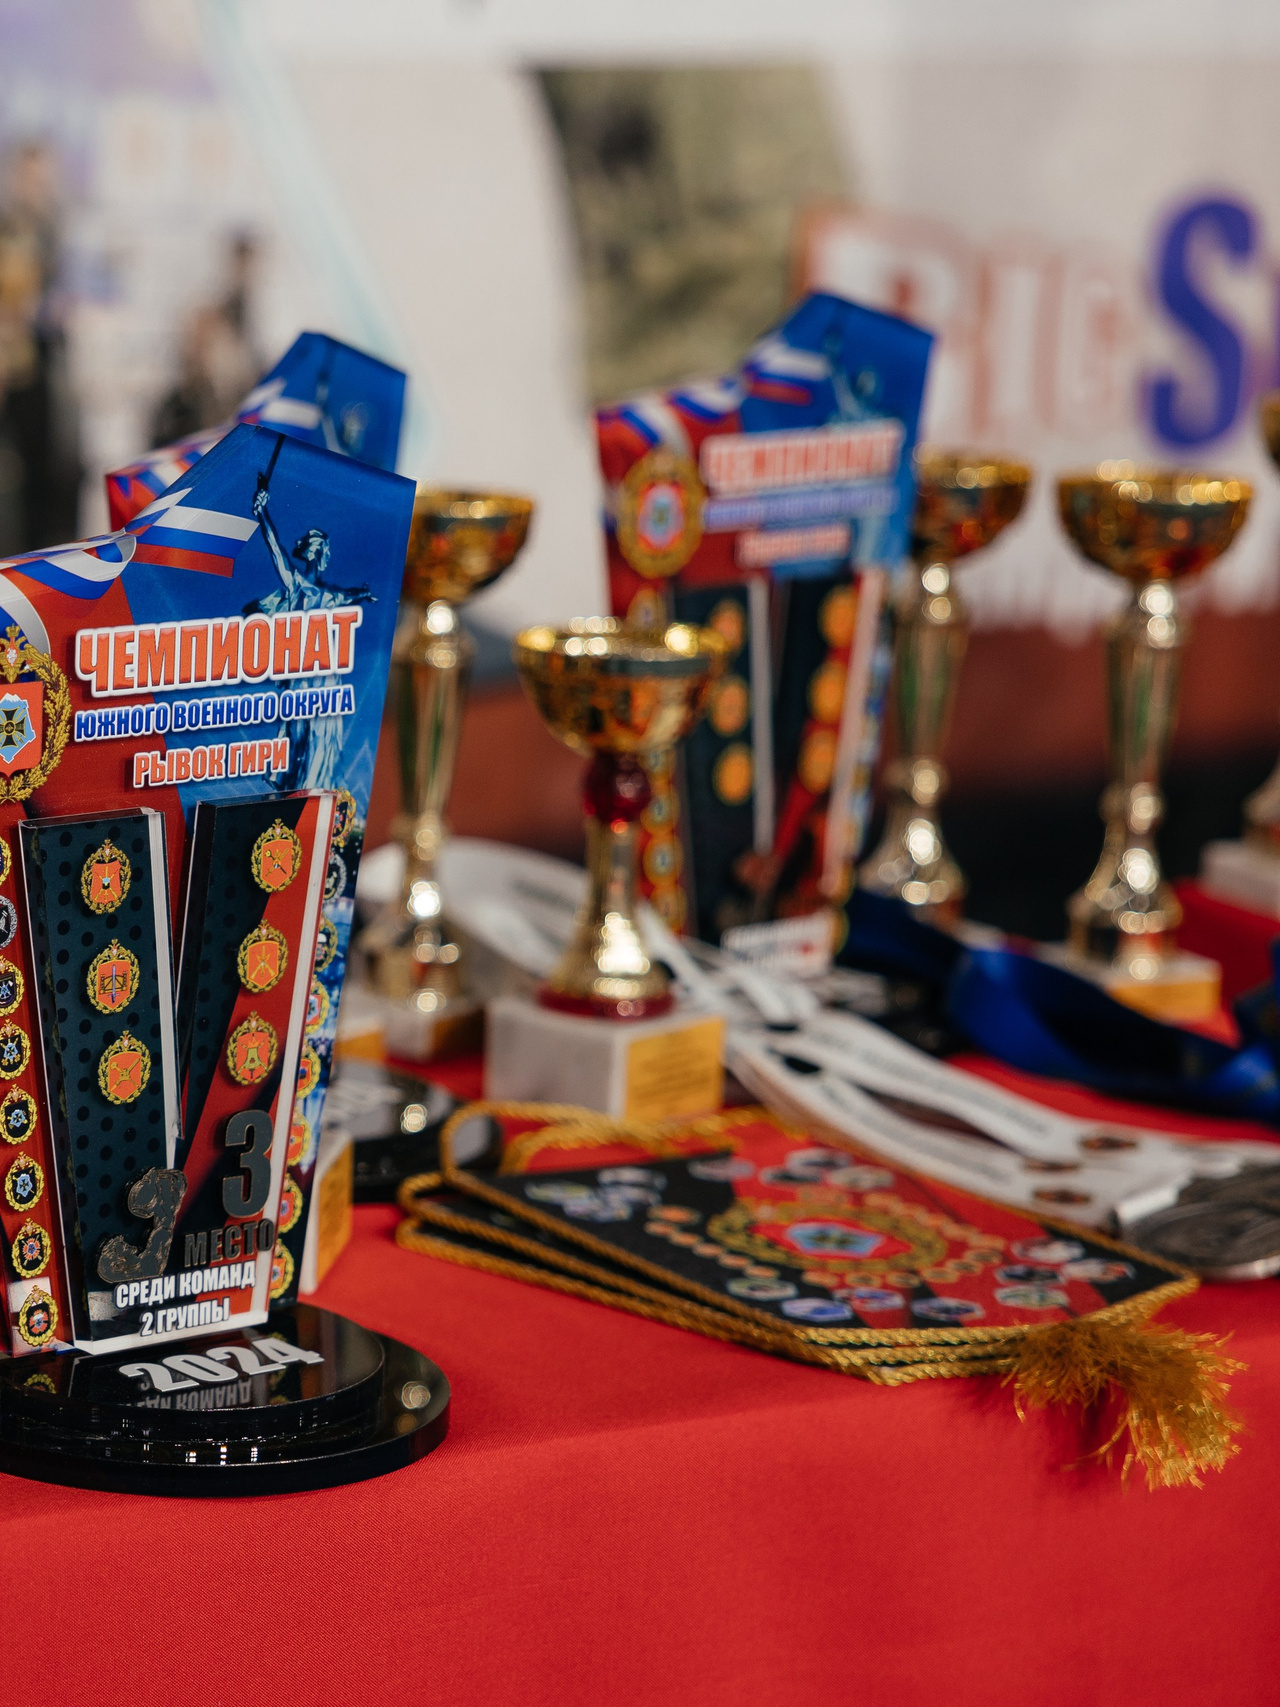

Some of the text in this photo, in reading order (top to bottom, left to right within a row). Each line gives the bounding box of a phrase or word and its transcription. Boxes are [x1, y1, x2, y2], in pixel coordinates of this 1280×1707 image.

[77, 608, 361, 694] ЧЕМПИОНАТ
[75, 685, 355, 742] ЮЖНОГО ВОЕННОГО ОКРУГА
[134, 738, 289, 787] РЫВОК ГИРИ
[222, 1109, 274, 1219] 3
[184, 1218, 274, 1268] МЕСТО
[115, 1260, 256, 1309] СРЕДИ КОМАНД
[140, 1298, 231, 1337] 2 ГРУППЫ
[119, 1337, 325, 1392] 2024
